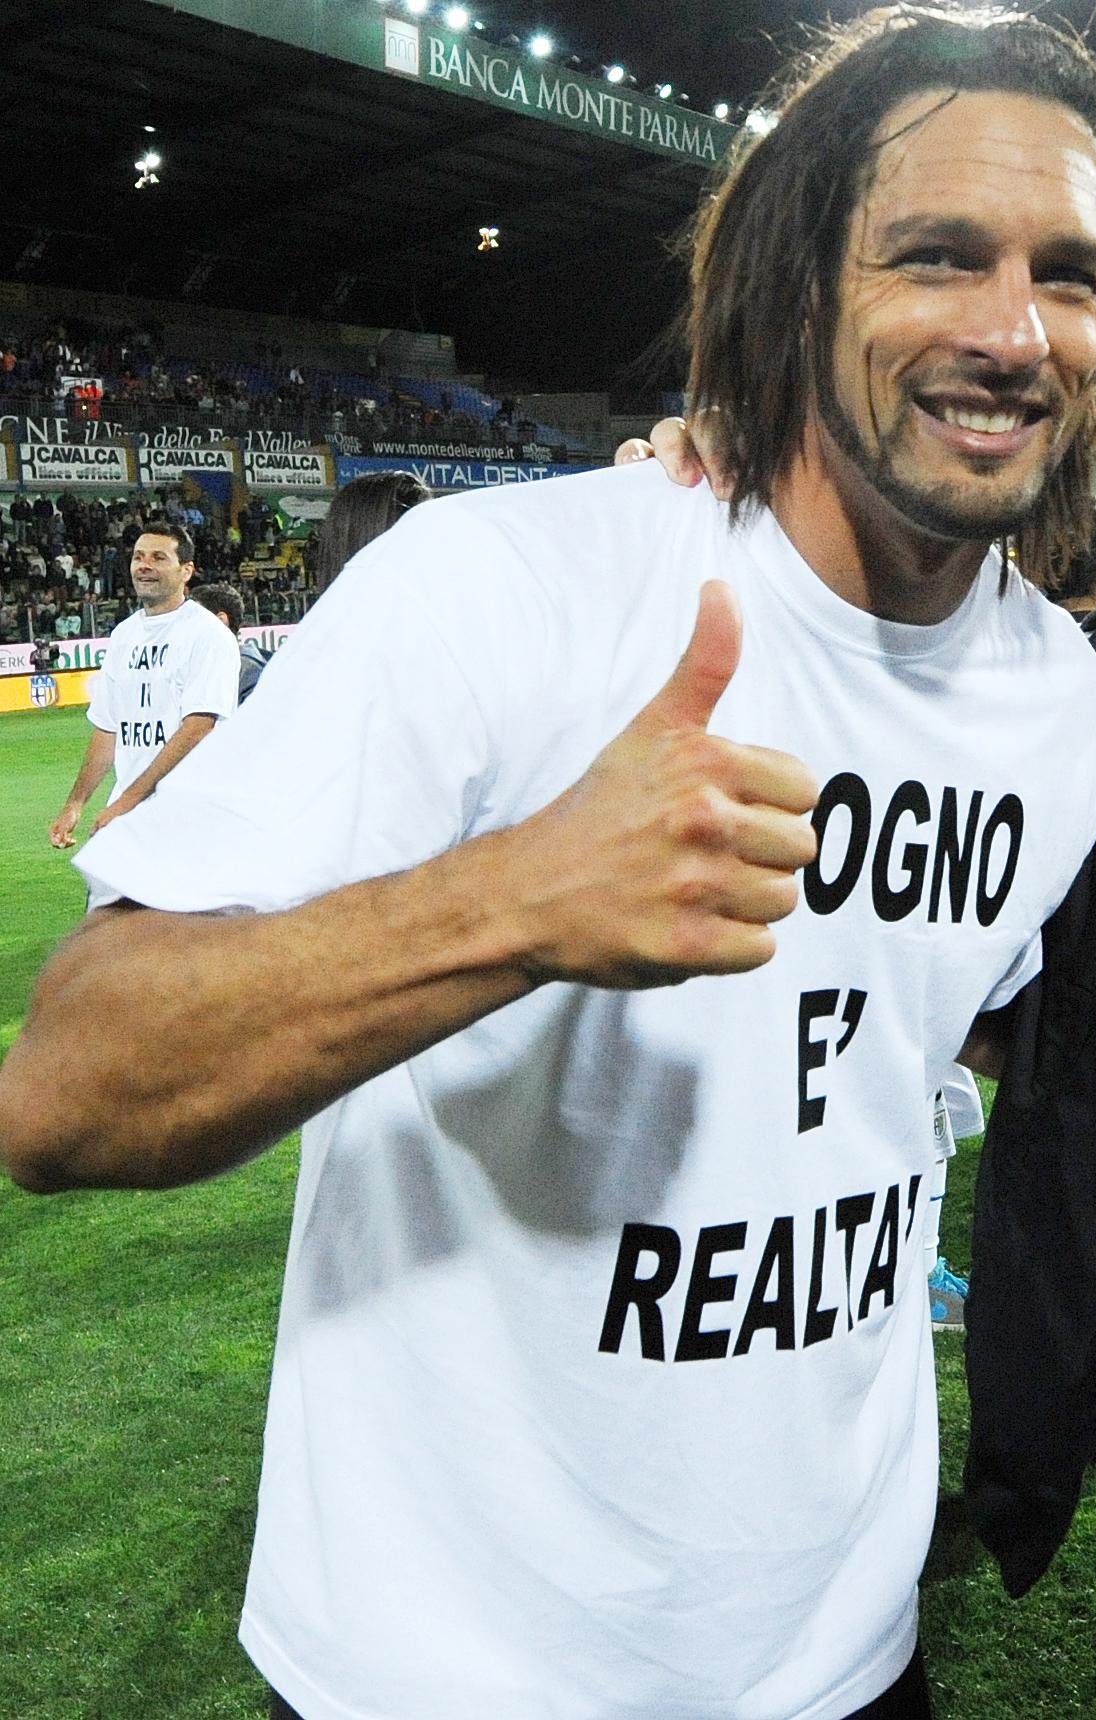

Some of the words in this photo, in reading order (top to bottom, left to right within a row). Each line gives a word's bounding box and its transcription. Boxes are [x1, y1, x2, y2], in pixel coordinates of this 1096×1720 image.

[427, 36, 531, 105] BANCA
[536, 74, 633, 136] MONTE
[639, 106, 717, 161] PARMA
[153, 426, 201, 450] della
[36, 446, 120, 464] CAVALCA
[152, 450, 228, 467] CAVALCA
[255, 454, 321, 471] CAVALCA
[372, 441, 515, 462] www.montedellevigne.it
[411, 463, 548, 487] VITALDENT
[802, 772, 1024, 927] OGNO
